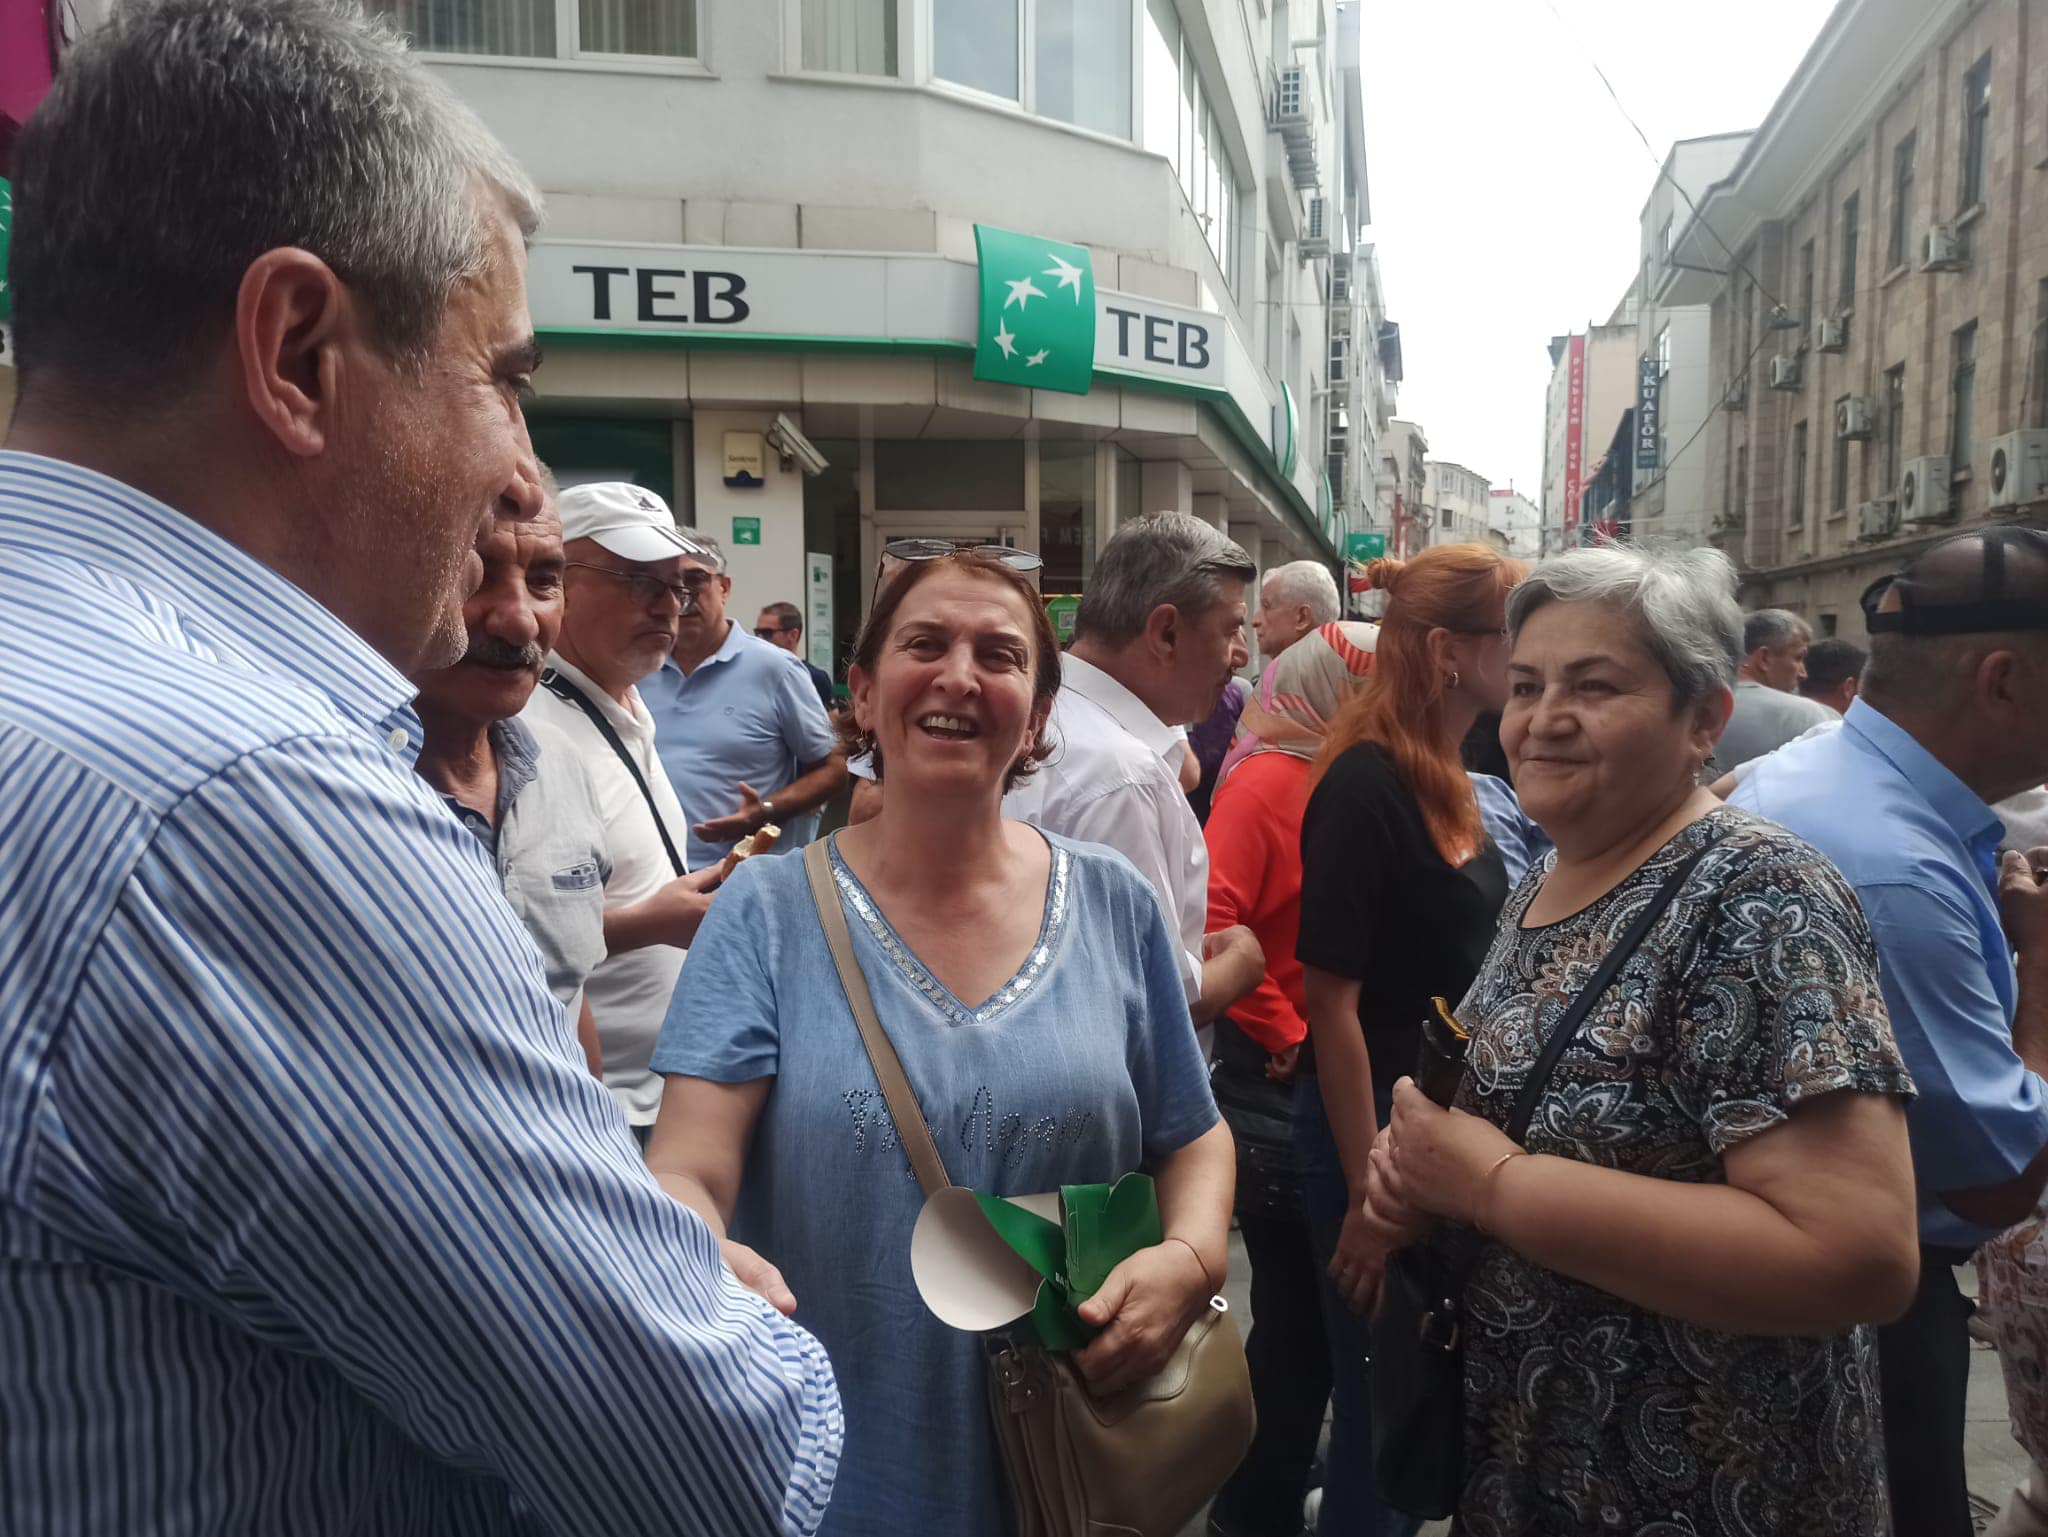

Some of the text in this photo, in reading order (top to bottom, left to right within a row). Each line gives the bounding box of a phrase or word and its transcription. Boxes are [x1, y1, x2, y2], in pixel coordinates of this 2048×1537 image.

[572, 265, 750, 324] TEB
[1106, 306, 1210, 369] TEB
[1641, 376, 1657, 449] KUAFÖR
